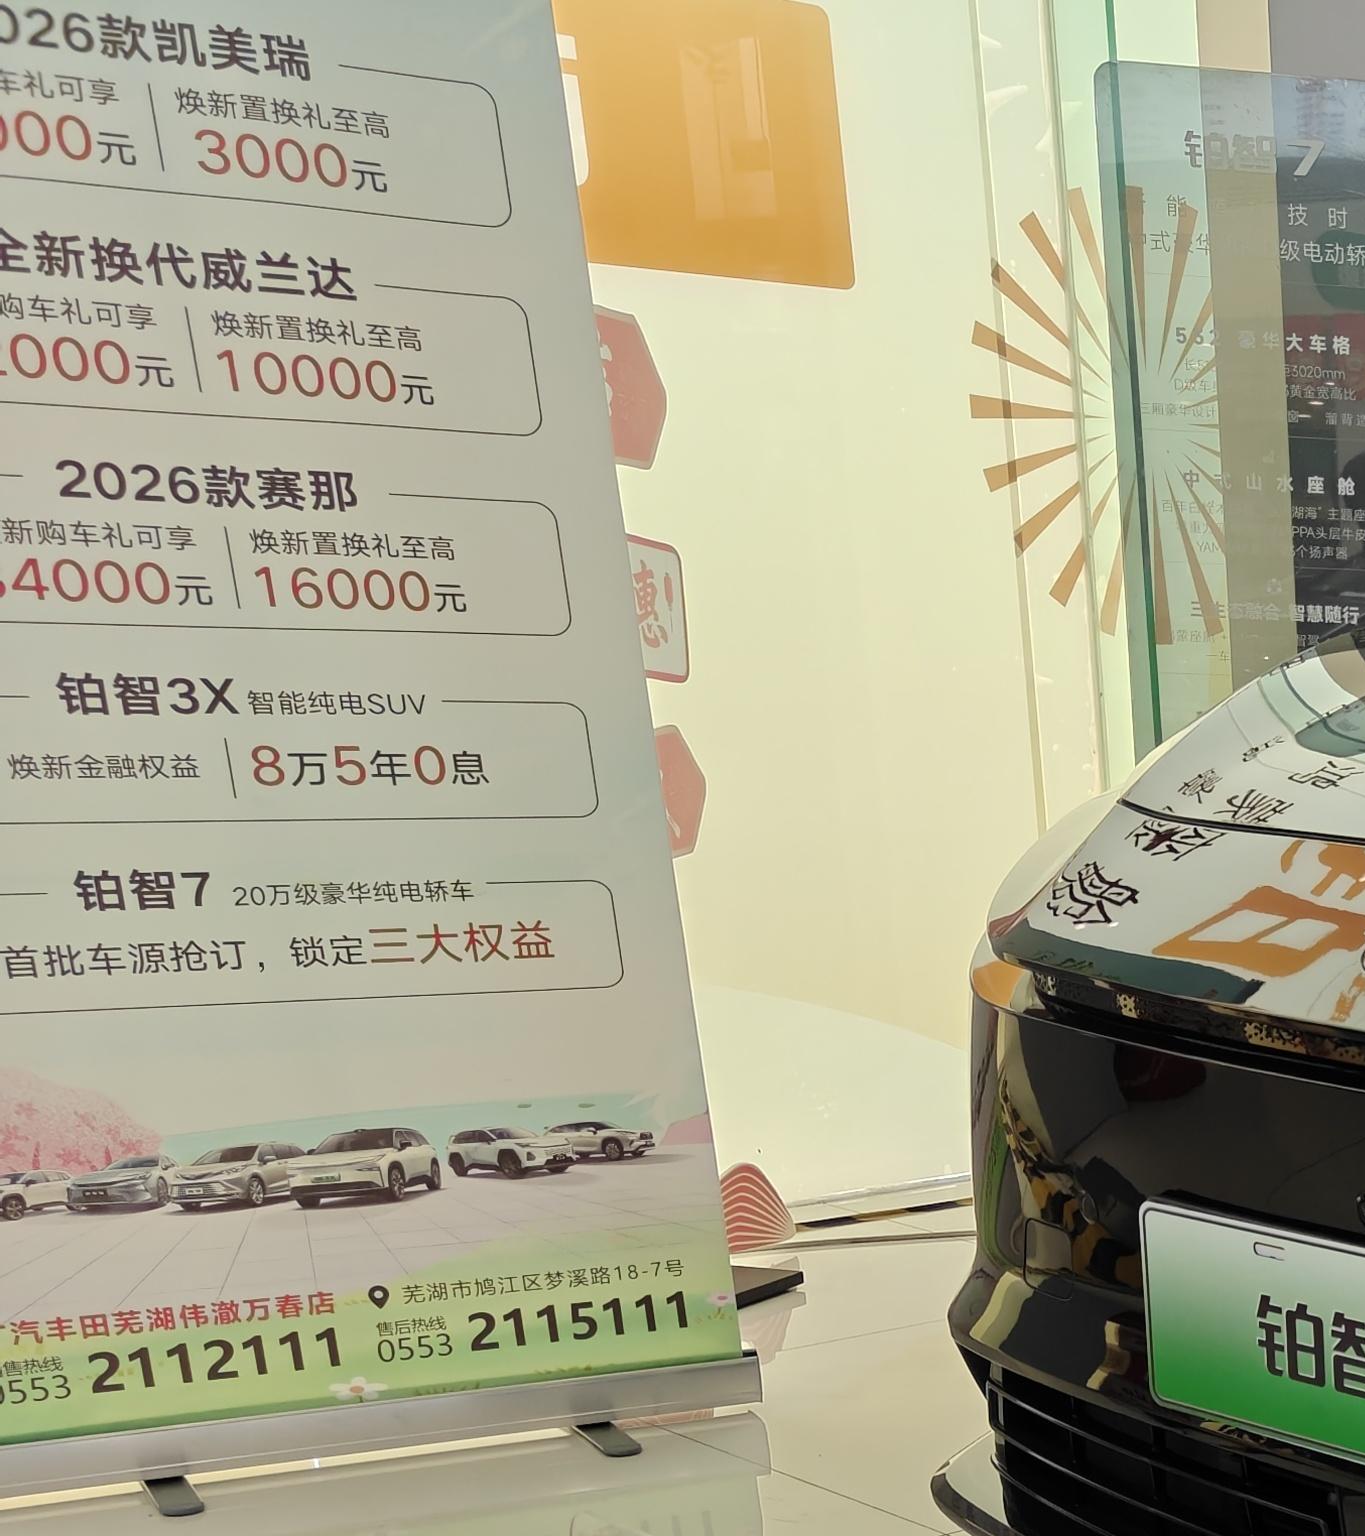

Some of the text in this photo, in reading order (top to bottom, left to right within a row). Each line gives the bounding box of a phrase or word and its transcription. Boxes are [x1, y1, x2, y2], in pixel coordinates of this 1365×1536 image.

[0, 110, 137, 166] 00元
[175, 88, 390, 139] 焕新置换礼至高
[195, 129, 388, 193] 3000元
[0, 226, 357, 301] 全新换代威兰达
[0, 292, 157, 330] 购车礼可享
[211, 310, 422, 351] 焕新置换礼至高
[0, 333, 174, 388] 000元
[217, 348, 434, 405] 10000元
[56, 459, 357, 512] 2026款赛那
[0, 518, 197, 550] 新购车礼可享
[249, 529, 455, 561] 焕新置换礼至高
[0, 557, 213, 606] 4000元
[254, 565, 467, 614] 16000元
[57, 671, 426, 718] 铂智3X 智能纯电SUV
[7, 754, 201, 781] 焕新金融权益
[250, 744, 490, 787] 8万5年0息
[74, 870, 475, 913] 铂智7 20万级豪华纯电轿车
[402, 1257, 685, 1306] 芜湖市鸠江区梦溪路18-7号
[0, 1291, 336, 1346] 汽丰田芜湖伟澈万春店
[376, 1316, 448, 1338] 售后热线
[378, 1291, 691, 1364] 0553 2115111
[0, 1327, 342, 1405] 553 2112111
